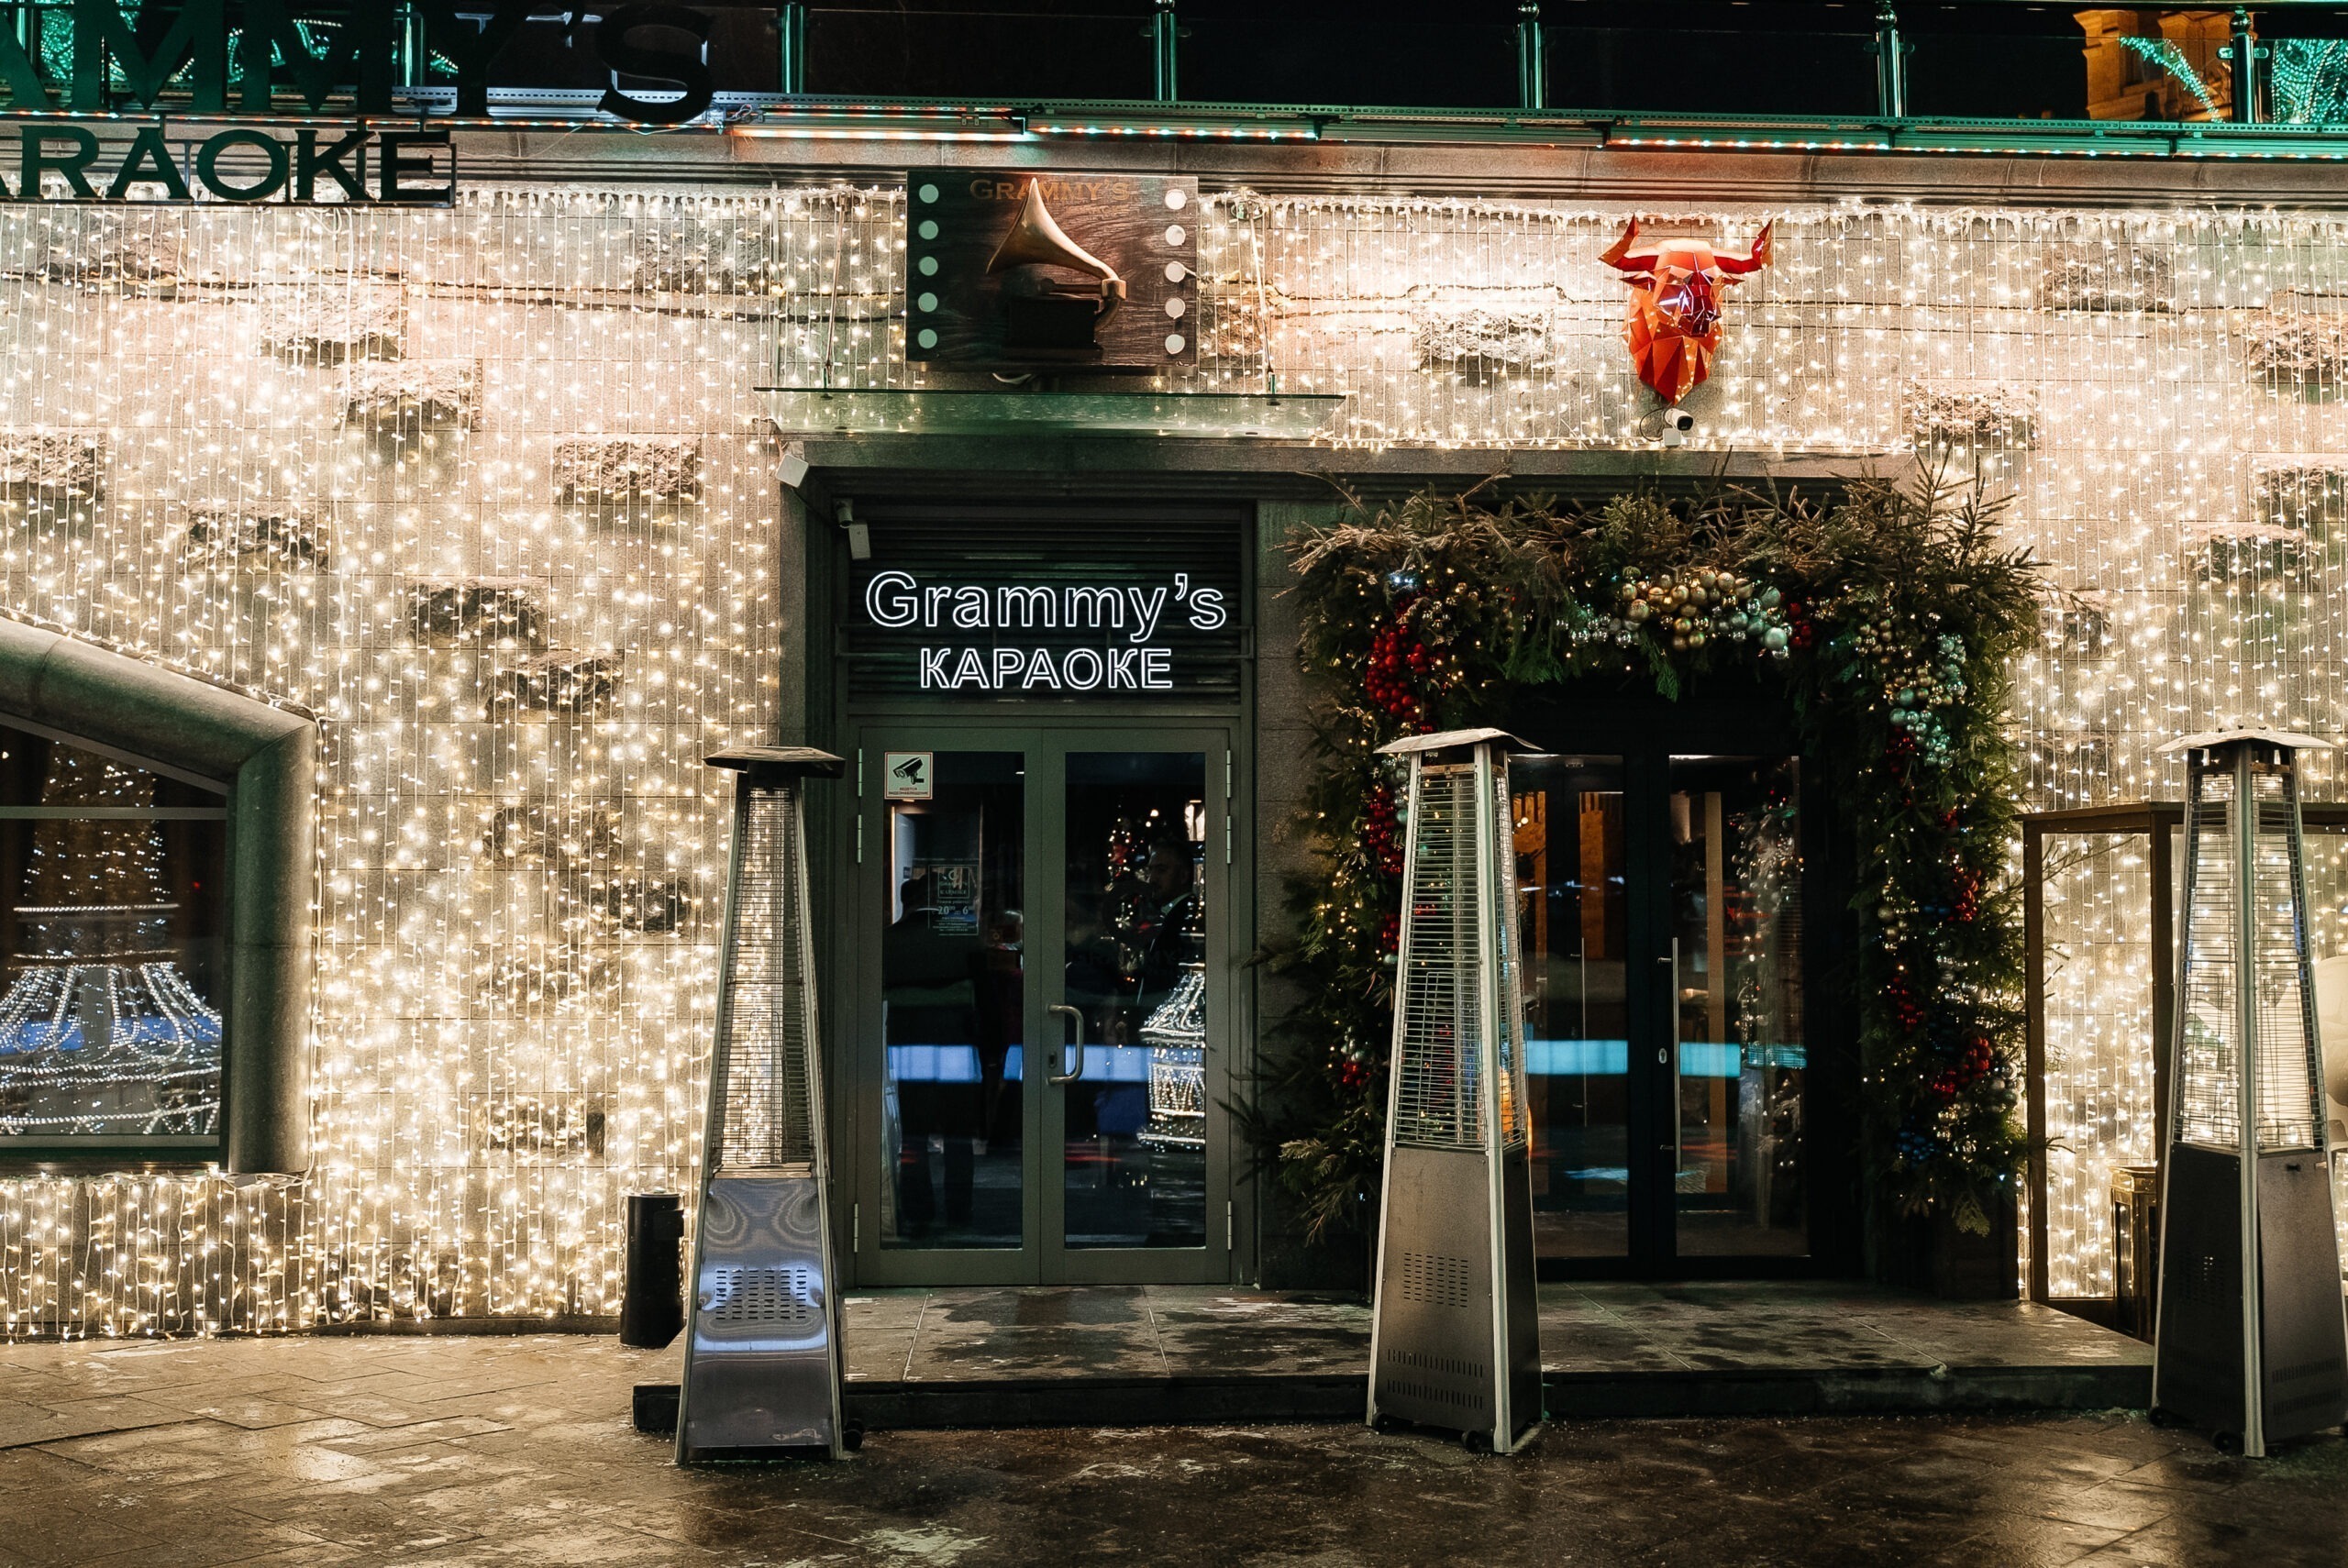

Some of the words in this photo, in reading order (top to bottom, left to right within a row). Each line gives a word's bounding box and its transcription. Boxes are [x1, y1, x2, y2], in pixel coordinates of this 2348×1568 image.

[0, 125, 451, 202] RAOKE
[866, 570, 1226, 643] Grammy's
[920, 647, 1173, 690] КАРАОКЕ
